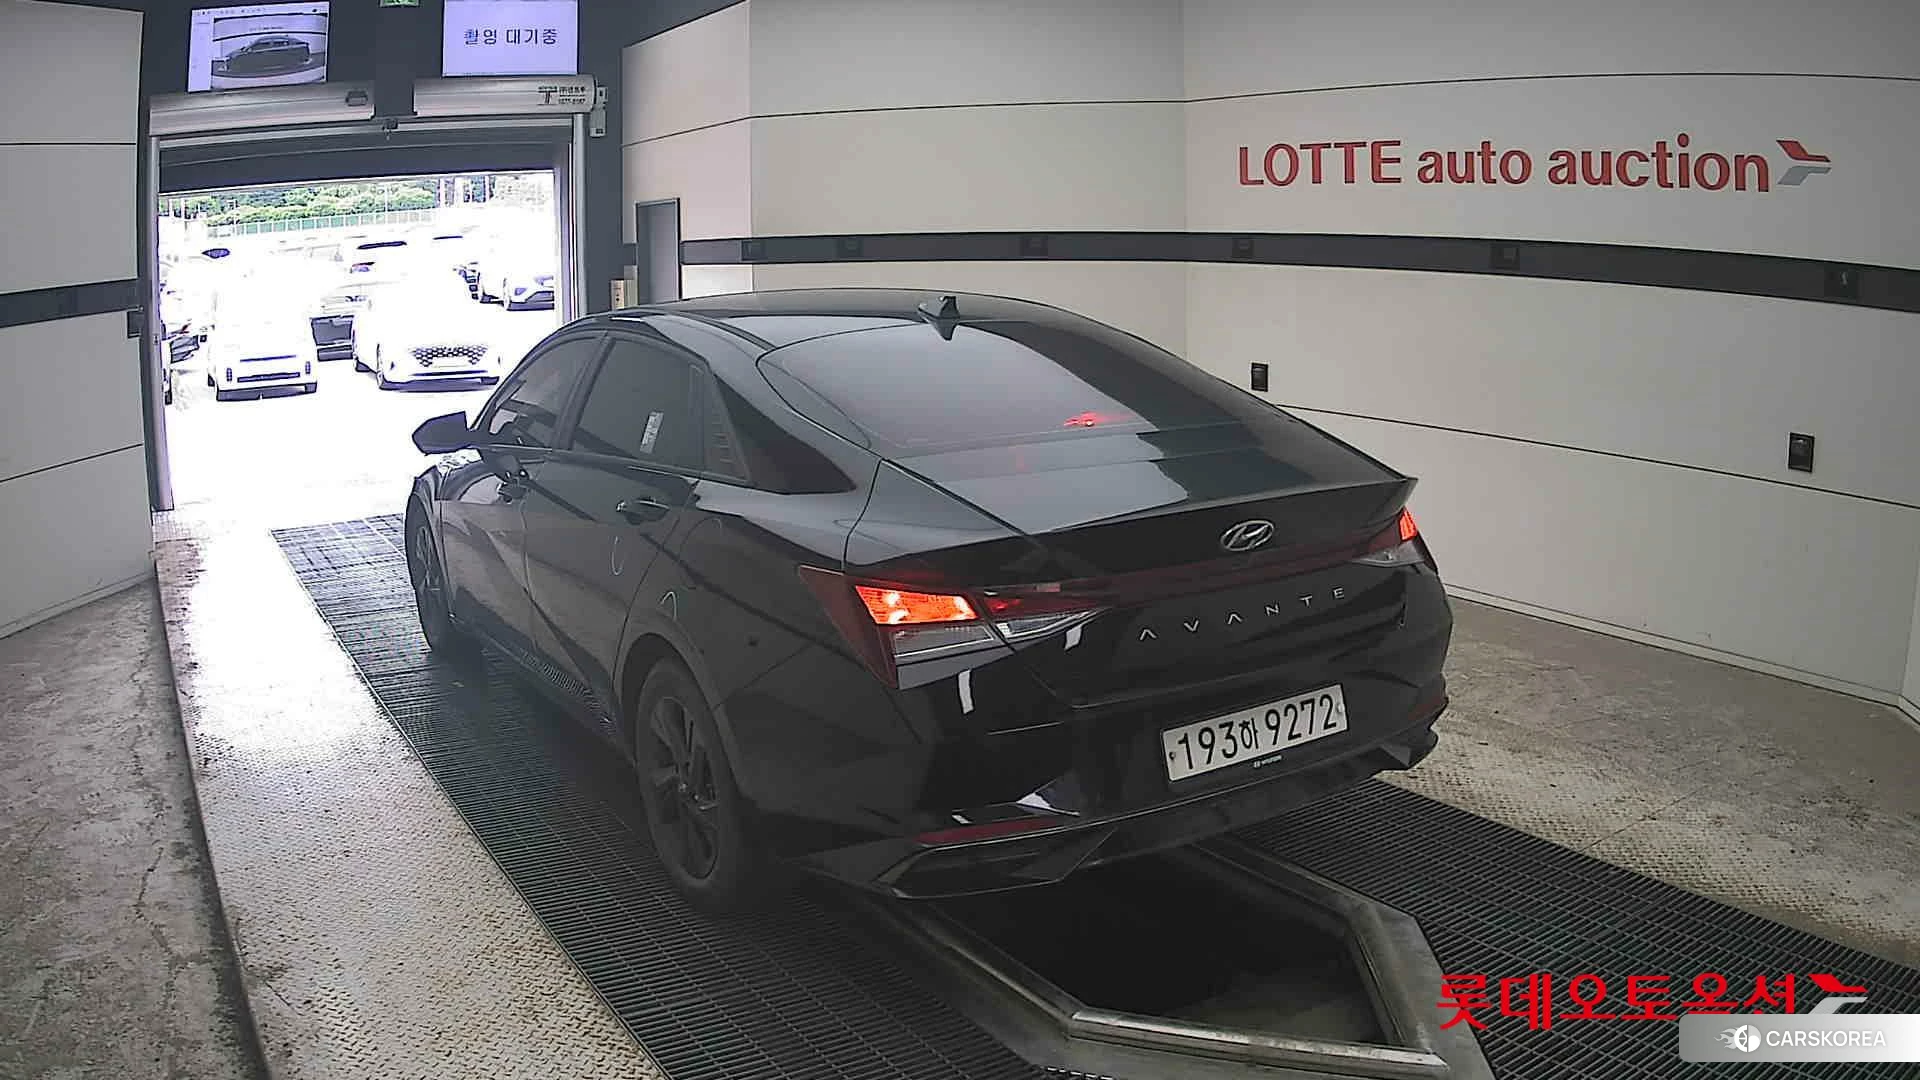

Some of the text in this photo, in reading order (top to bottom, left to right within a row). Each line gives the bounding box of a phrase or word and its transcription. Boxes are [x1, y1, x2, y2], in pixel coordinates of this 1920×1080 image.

[506, 28, 557, 45] 대기중
[1239, 133, 1769, 192] LOTTE auto auction
[1139, 587, 1345, 641] AVANTE
[1265, 694, 1337, 747] 9272
